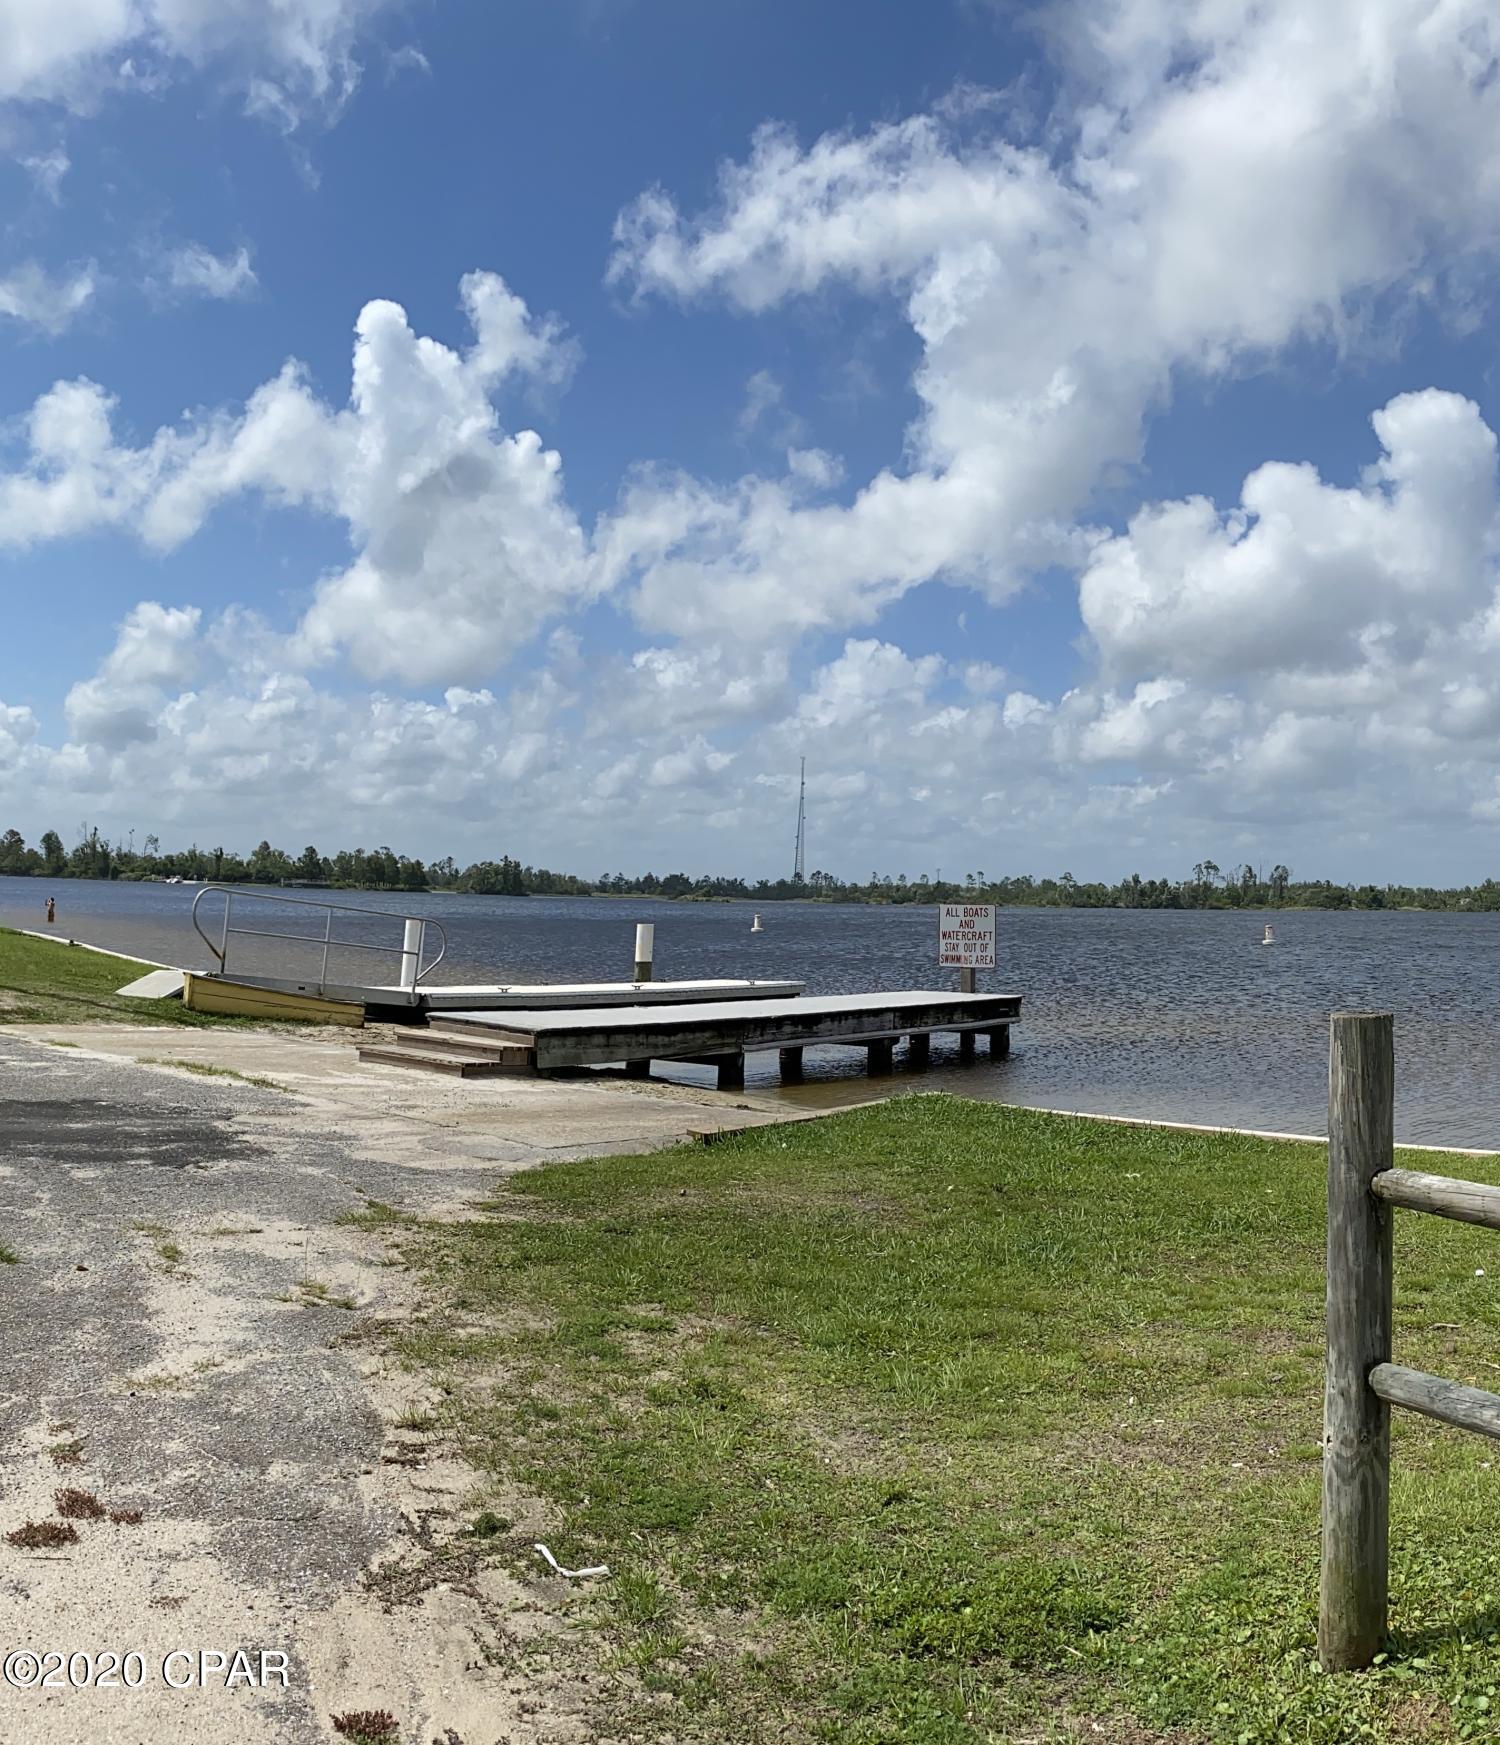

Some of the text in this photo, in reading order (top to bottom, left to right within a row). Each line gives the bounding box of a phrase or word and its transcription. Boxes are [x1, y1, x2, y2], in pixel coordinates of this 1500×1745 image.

[946, 907, 989, 917] ALL BOATS
[959, 920, 975, 929] AND
[942, 931, 992, 940] WATERCRAFT
[944, 943, 989, 953] STAY OUT OF
[940, 954, 993, 964] SWIMMNG AREA
